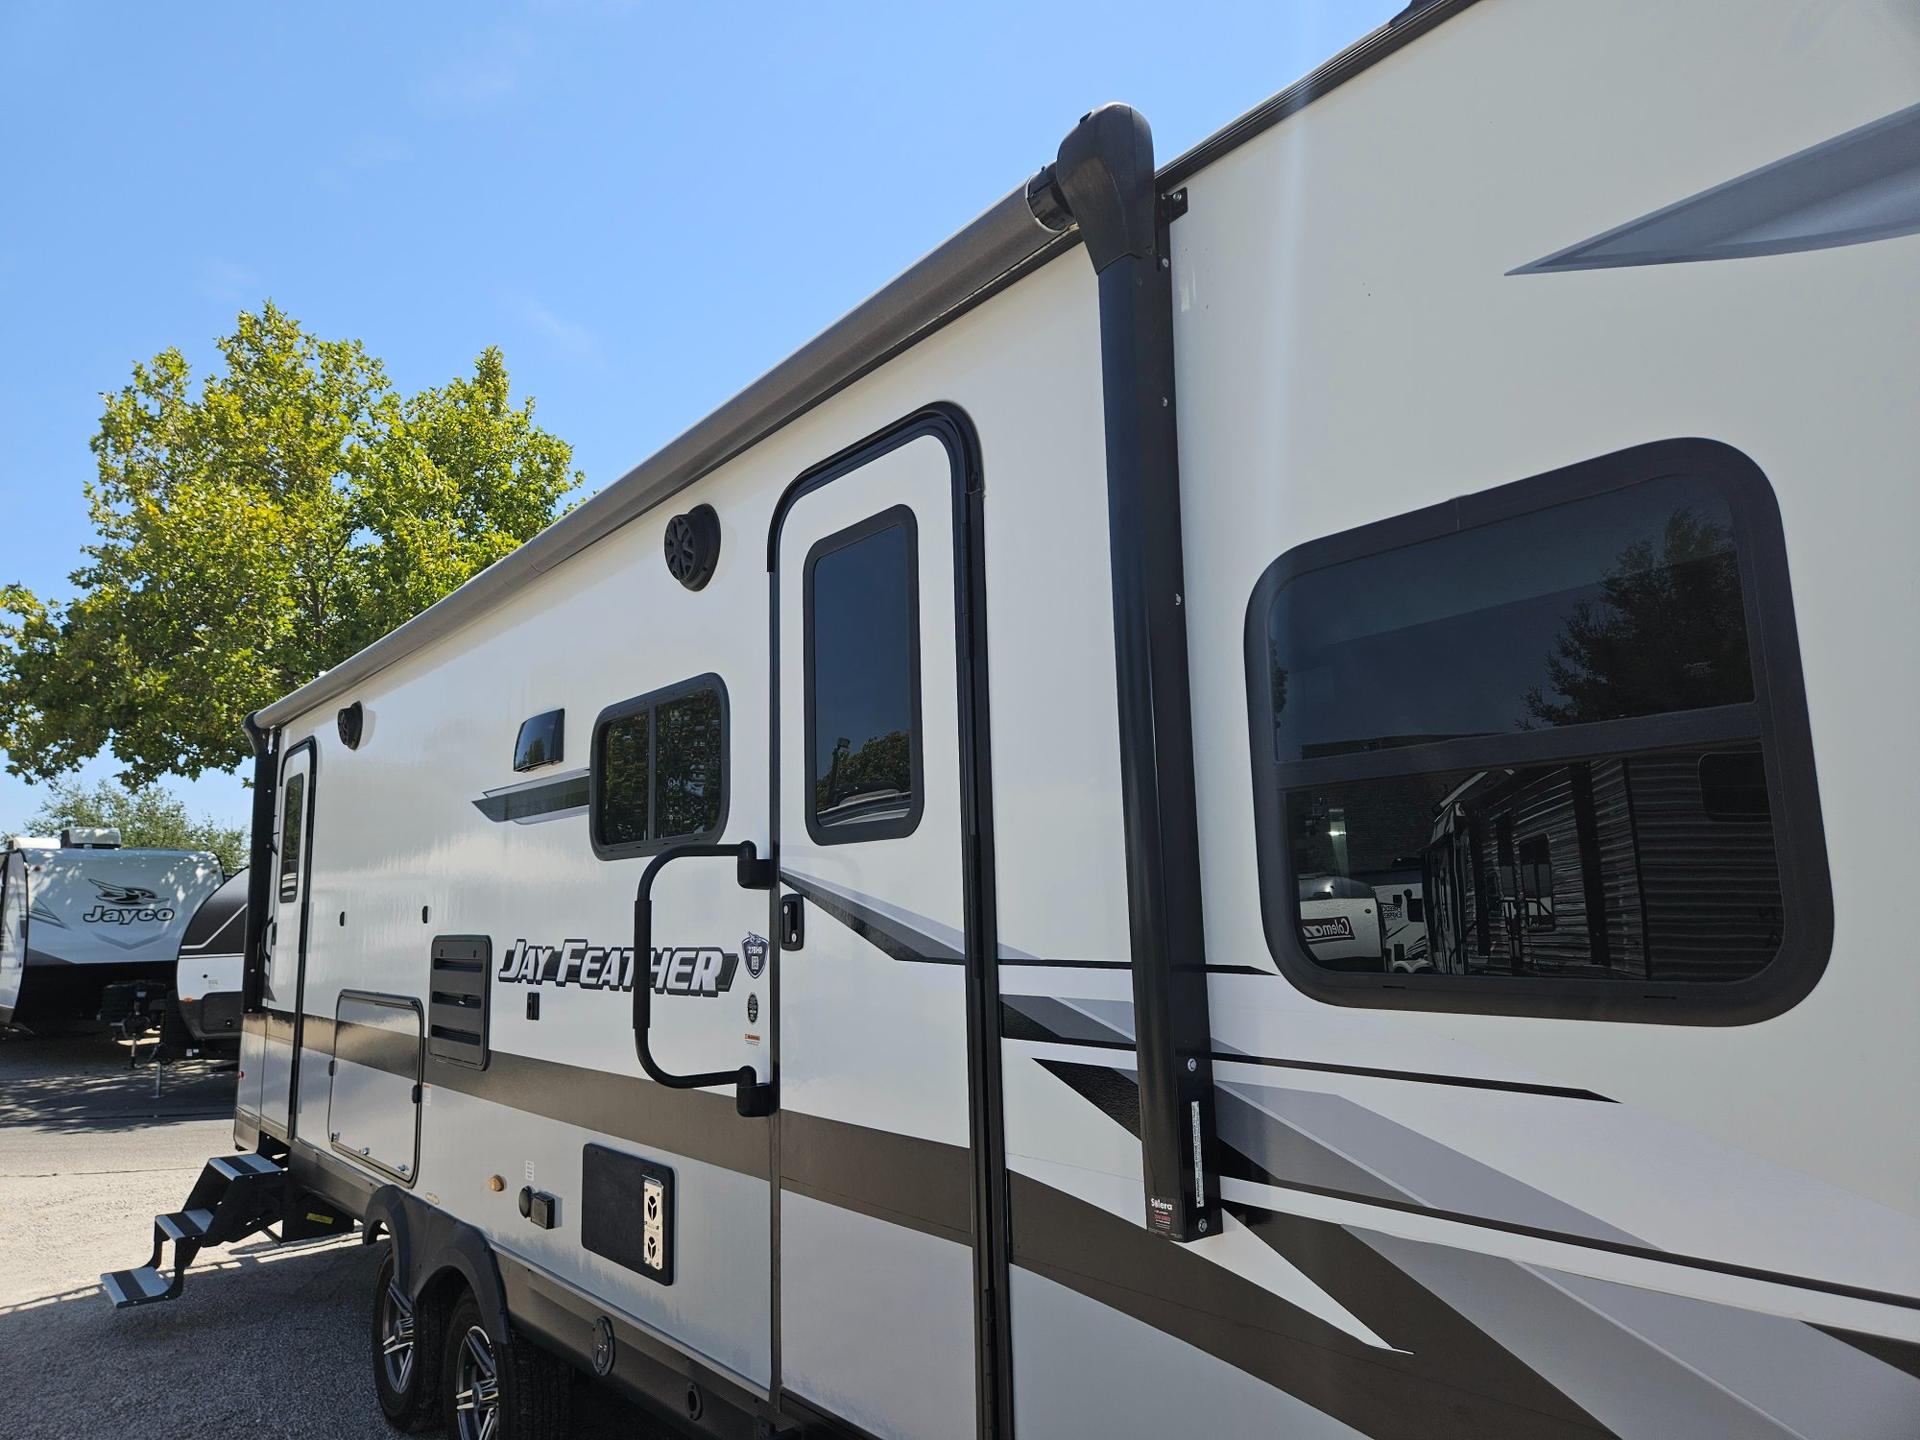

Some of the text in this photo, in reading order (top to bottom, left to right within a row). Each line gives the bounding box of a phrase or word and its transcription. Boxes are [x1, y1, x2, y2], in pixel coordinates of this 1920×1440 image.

[83, 905, 174, 926] Jayco
[555, 939, 723, 997] FEATHER
[1150, 1197, 1173, 1211] Solera
